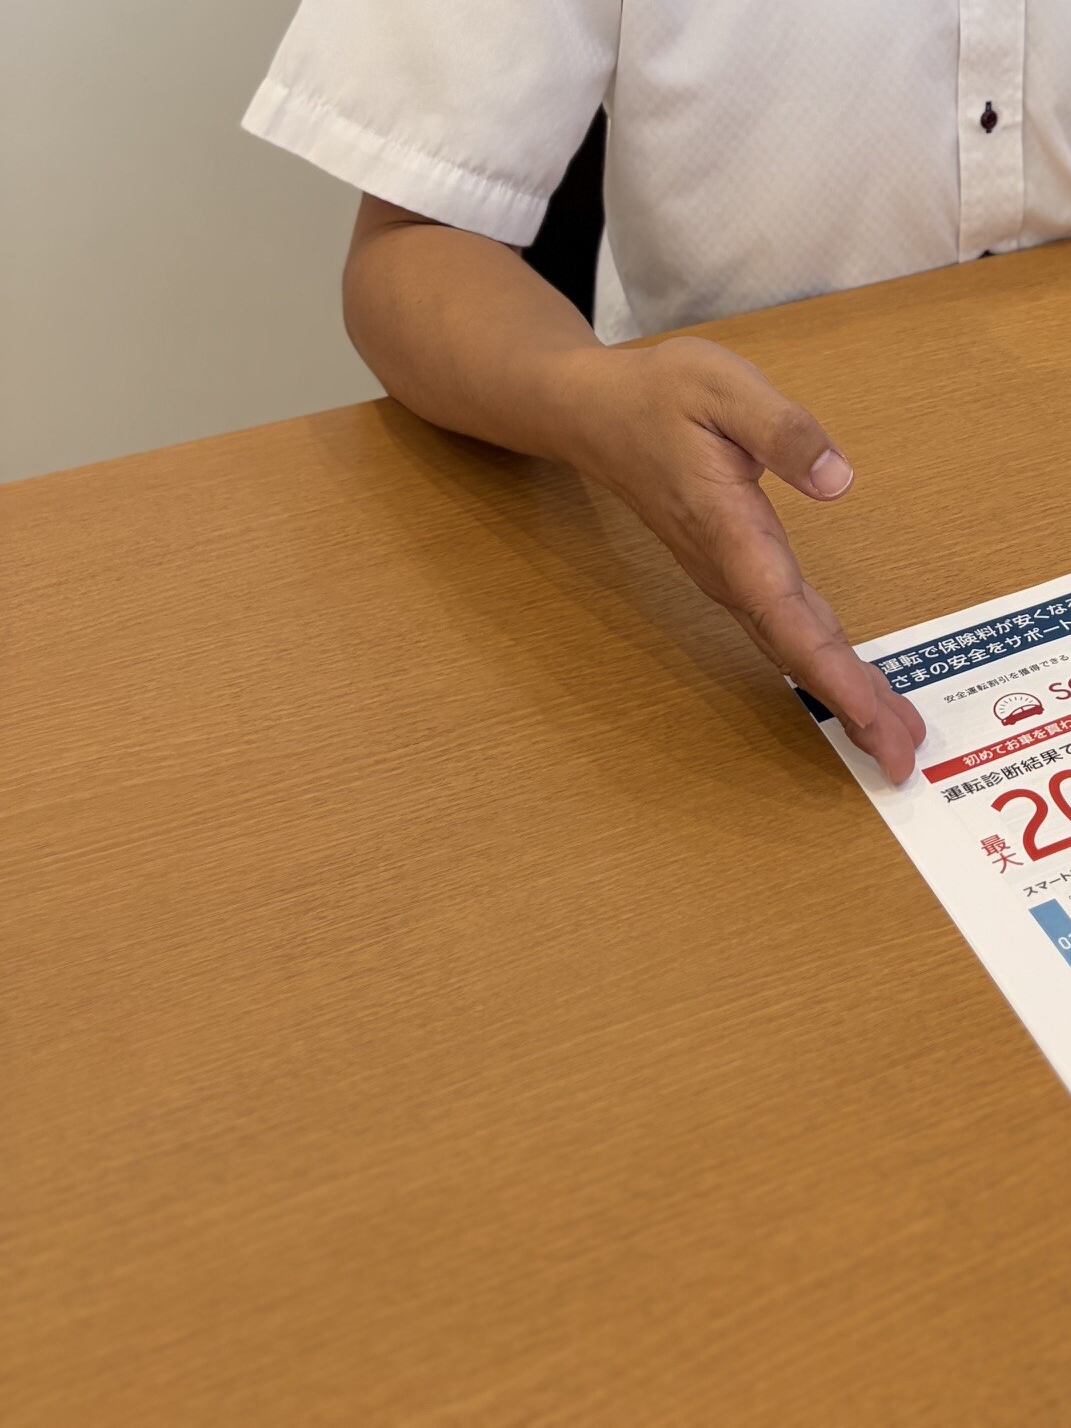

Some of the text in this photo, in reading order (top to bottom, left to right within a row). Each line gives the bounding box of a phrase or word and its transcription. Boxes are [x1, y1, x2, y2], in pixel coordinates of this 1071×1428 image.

[942, 653, 1071, 703] 安全運転割引を獲得できる
